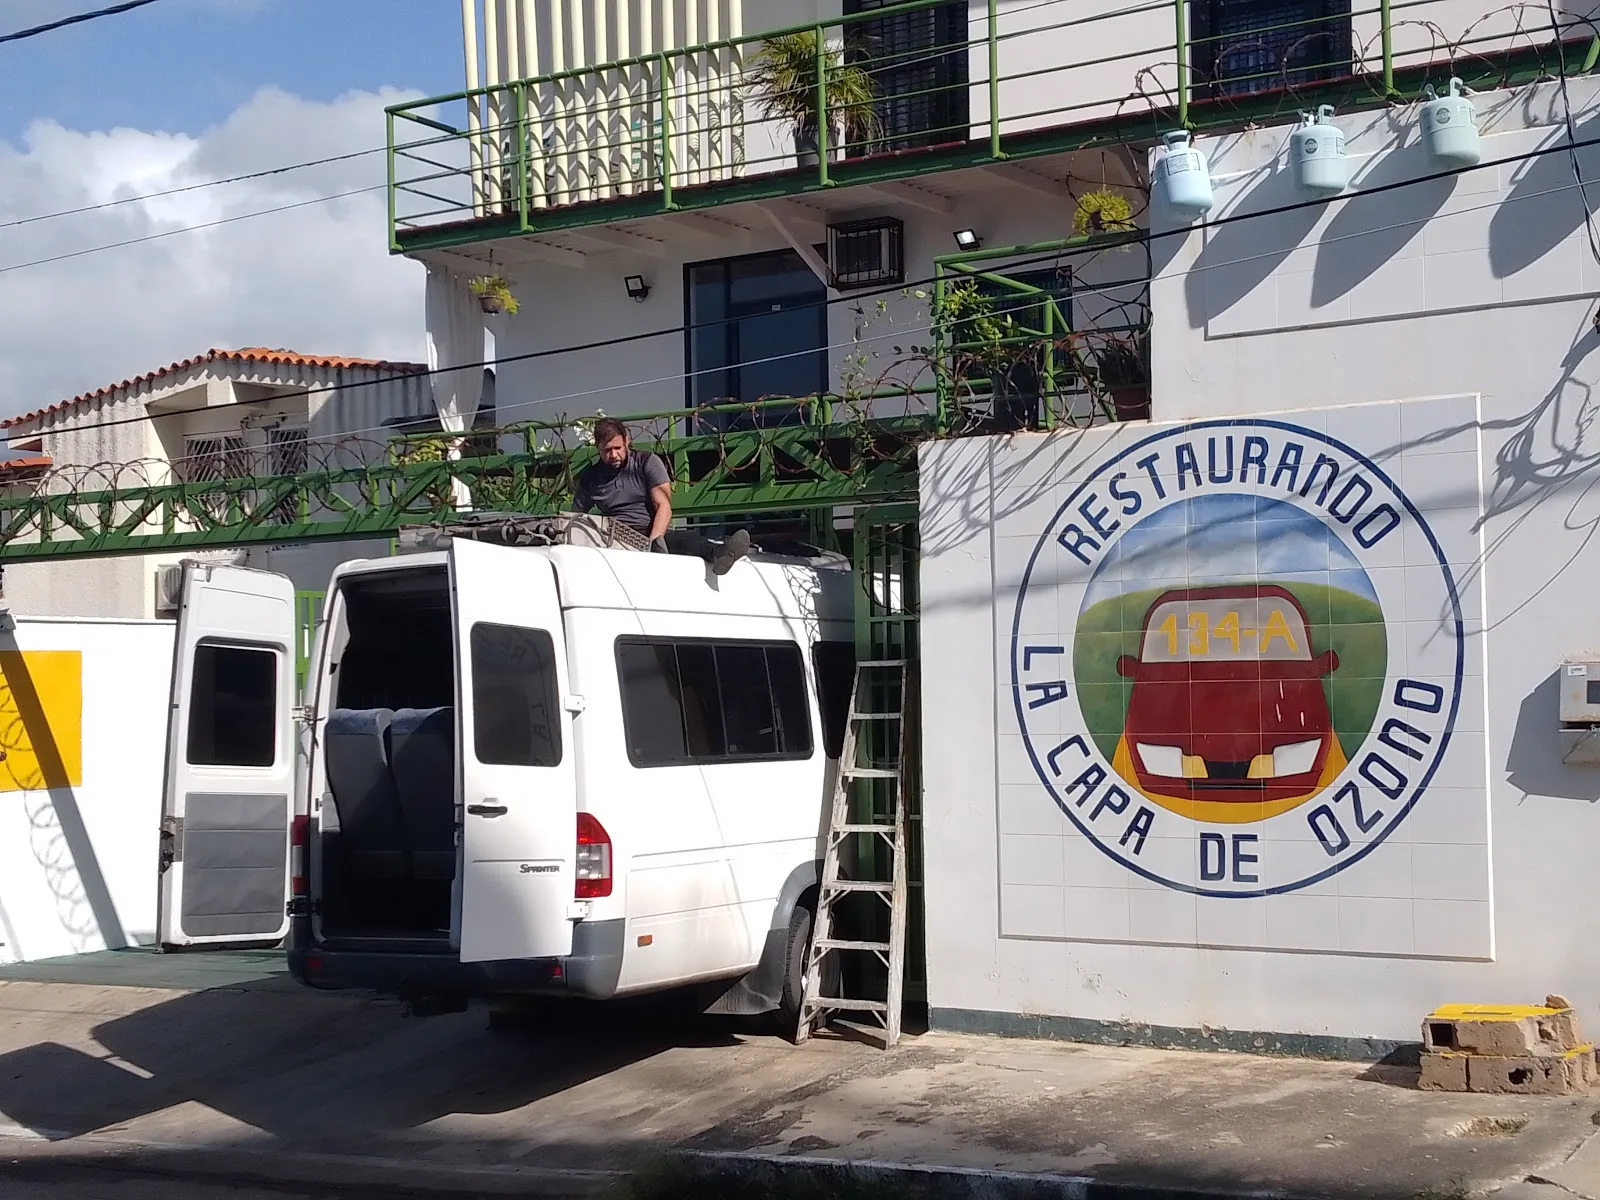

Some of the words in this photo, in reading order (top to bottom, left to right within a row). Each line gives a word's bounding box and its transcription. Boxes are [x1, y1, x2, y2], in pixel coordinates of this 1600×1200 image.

[1056, 435, 1401, 565] RESTAURANDO
[1159, 609, 1299, 655] 134-A
[1023, 645, 1068, 709] LA
[1047, 734, 1155, 856] CAPA
[1199, 832, 1259, 883] DE
[1306, 678, 1444, 857] OZONO
